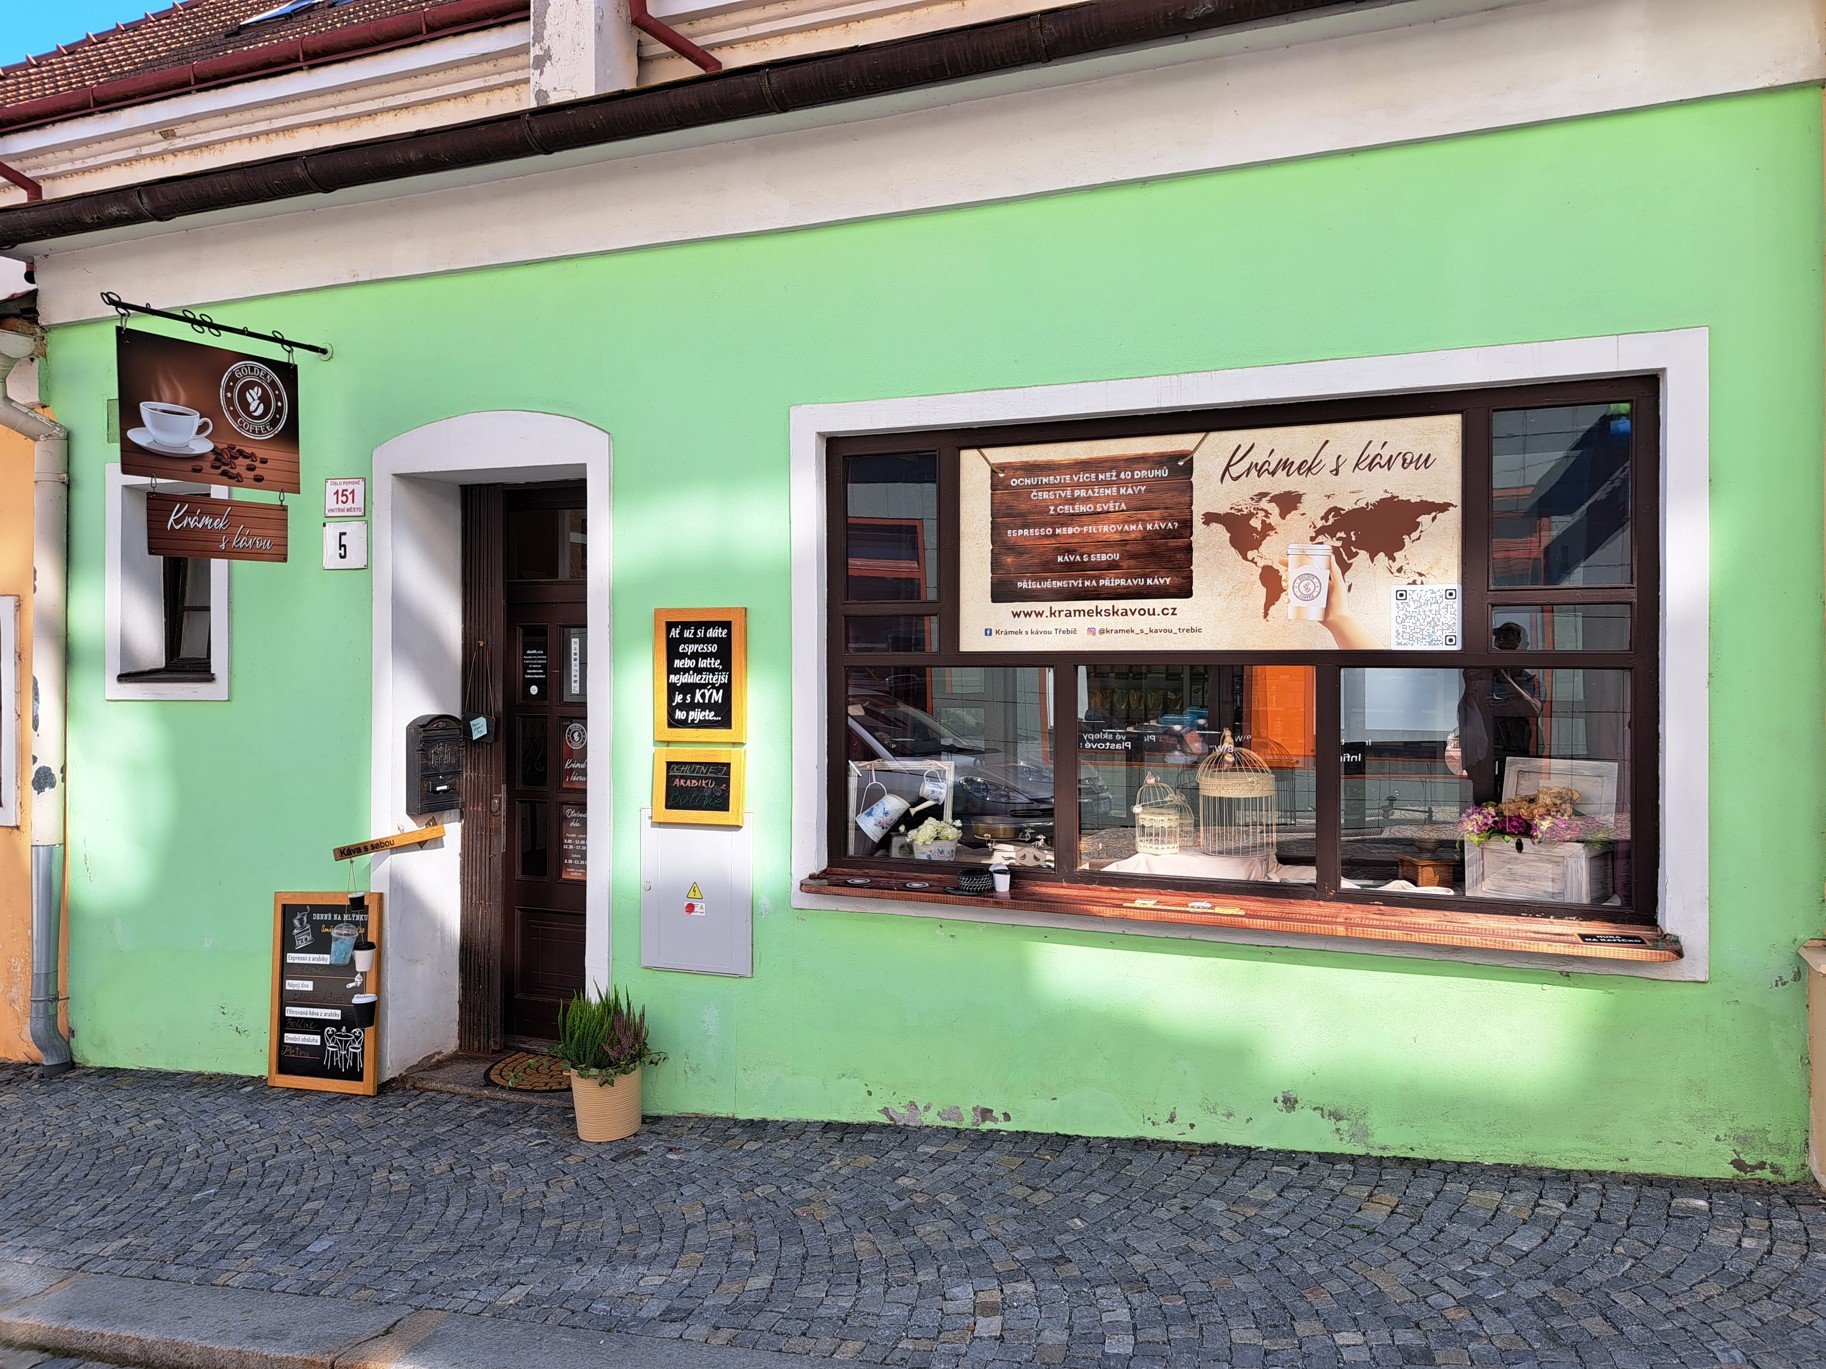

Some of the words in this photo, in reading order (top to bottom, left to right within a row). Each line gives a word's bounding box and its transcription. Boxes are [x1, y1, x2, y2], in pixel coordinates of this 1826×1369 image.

[234, 366, 273, 384] GOLDEN
[236, 417, 273, 434] COFFEE
[1220, 440, 1329, 484] Krámek
[1330, 455, 1348, 476] s
[1352, 440, 1437, 473] kávou
[1010, 476, 1071, 486] OCHUTNEJTE
[1072, 472, 1096, 482] VÍCE
[1098, 470, 1117, 481] NEŽ
[1119, 471, 1132, 480] 40
[1134, 466, 1169, 478] DRUHŮ
[334, 488, 355, 504] 151
[1074, 485, 1118, 498] PRAŽENÉ
[1119, 484, 1147, 495] KÁVY
[1048, 506, 1055, 514] Z
[1057, 503, 1094, 514] CELÉHO
[1096, 502, 1127, 512] SVĚTA
[167, 502, 232, 531] Krámek
[1007, 528, 1053, 537] ESPRESSO
[1055, 526, 1080, 535] NEBO
[1083, 522, 1143, 534] FILTROVANÁ
[1146, 521, 1179, 531] KÁVA?
[220, 534, 228, 550] s
[231, 524, 274, 550] kávou
[338, 532, 347, 559] 5
[1057, 553, 1081, 563] KÁVA
[1090, 553, 1120, 561] SEBOU
[1017, 578, 1083, 589] PŘÍSLUŠENSTVÍ
[1099, 577, 1145, 587] PŘÍPRAVU
[1146, 576, 1171, 585] KÁVY
[1011, 605, 1178, 619] www.kramekskavou.cz
[669, 625, 681, 638] Ať
[684, 627, 695, 638] už
[696, 627, 704, 638] si
[706, 626, 728, 638] dáte
[1098, 627, 1203, 636] @kramek_s_kavou_trebic
[679, 644, 718, 655] espresso
[674, 658, 695, 668] nebo
[698, 658, 723, 670] latte,
[669, 670, 729, 686] nejdůležitější
[672, 692, 683, 706] je
[686, 694, 692, 703] s
[694, 685, 723, 703] KÝM
[675, 709, 686, 720] ho
[688, 709, 721, 723] pijete...
[669, 764, 727, 775] OCHUTNEJ
[672, 778, 715, 788] ARABIKU
[339, 846, 362, 858] Káva
[370, 839, 395, 851] sebou
[288, 954, 307, 962] Espresso
